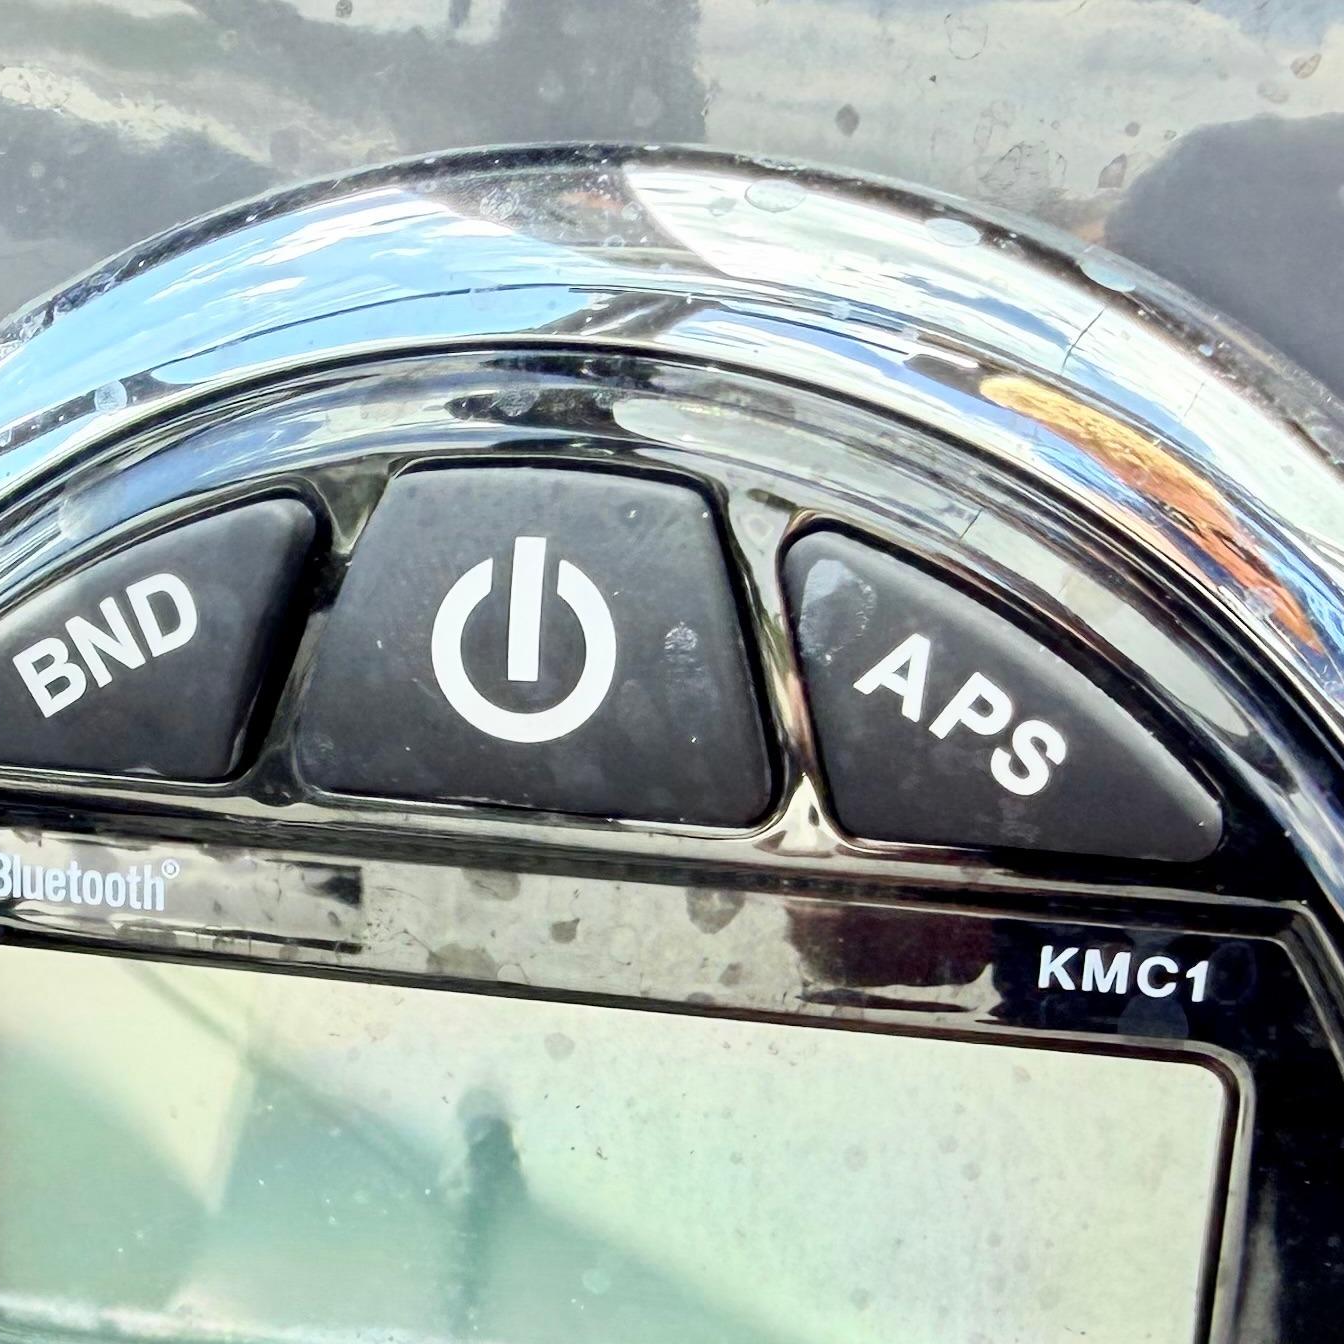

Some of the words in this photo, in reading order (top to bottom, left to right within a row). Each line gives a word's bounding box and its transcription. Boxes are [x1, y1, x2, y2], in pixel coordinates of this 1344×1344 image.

[12, 572, 198, 716] BND
[854, 632, 1065, 797] APS
[1039, 945, 1210, 1002] KMC1
